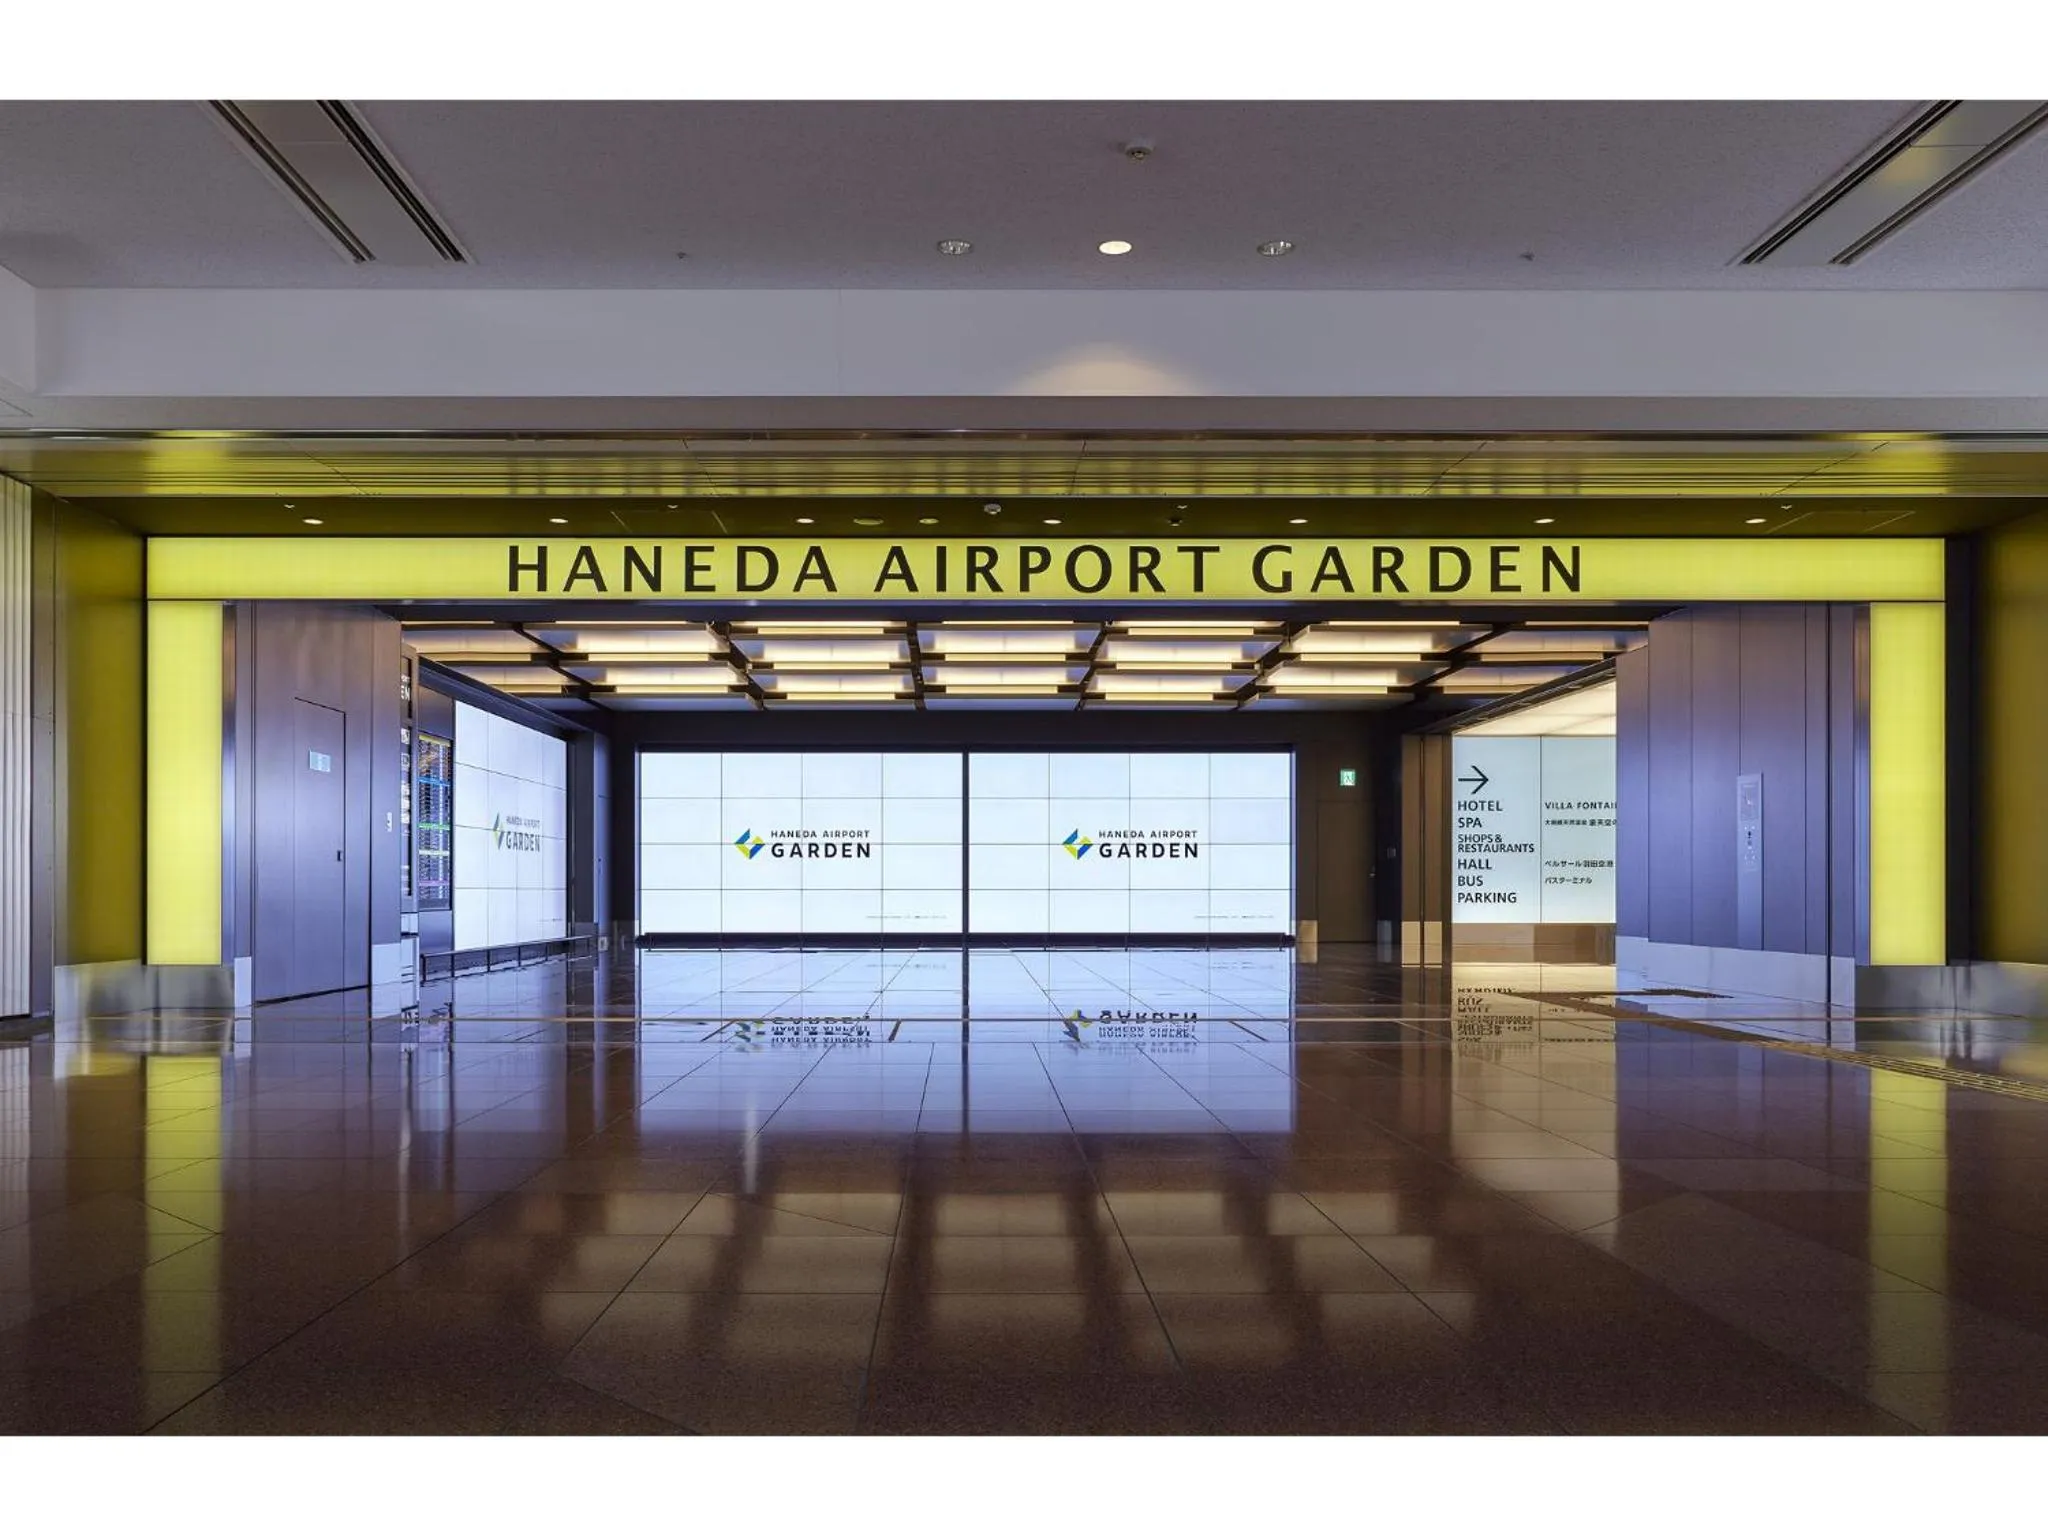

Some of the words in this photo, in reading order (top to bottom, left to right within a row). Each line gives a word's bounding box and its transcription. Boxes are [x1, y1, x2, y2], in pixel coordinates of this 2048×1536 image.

[508, 545, 838, 593] HANEDA
[873, 545, 1220, 593] AIRPORT
[1252, 545, 1581, 593] GARDEN
[1457, 800, 1503, 812] HOTEL
[1545, 802, 1573, 810] VILLA
[1457, 817, 1483, 829] SPA
[770, 830, 817, 838] HANEDA
[822, 830, 870, 838] AIRPORT
[1098, 830, 1145, 838] HANEDA
[1150, 830, 1197, 838] AIRPORT
[506, 831, 540, 852] GARDEN
[771, 842, 870, 858] GARDEN
[1099, 842, 1198, 858] GARDEN
[1457, 843, 1535, 853] RESTAURANTS
[1457, 859, 1493, 870] HALL
[1457, 875, 1484, 887] BUS
[1457, 892, 1517, 903] PARKING
